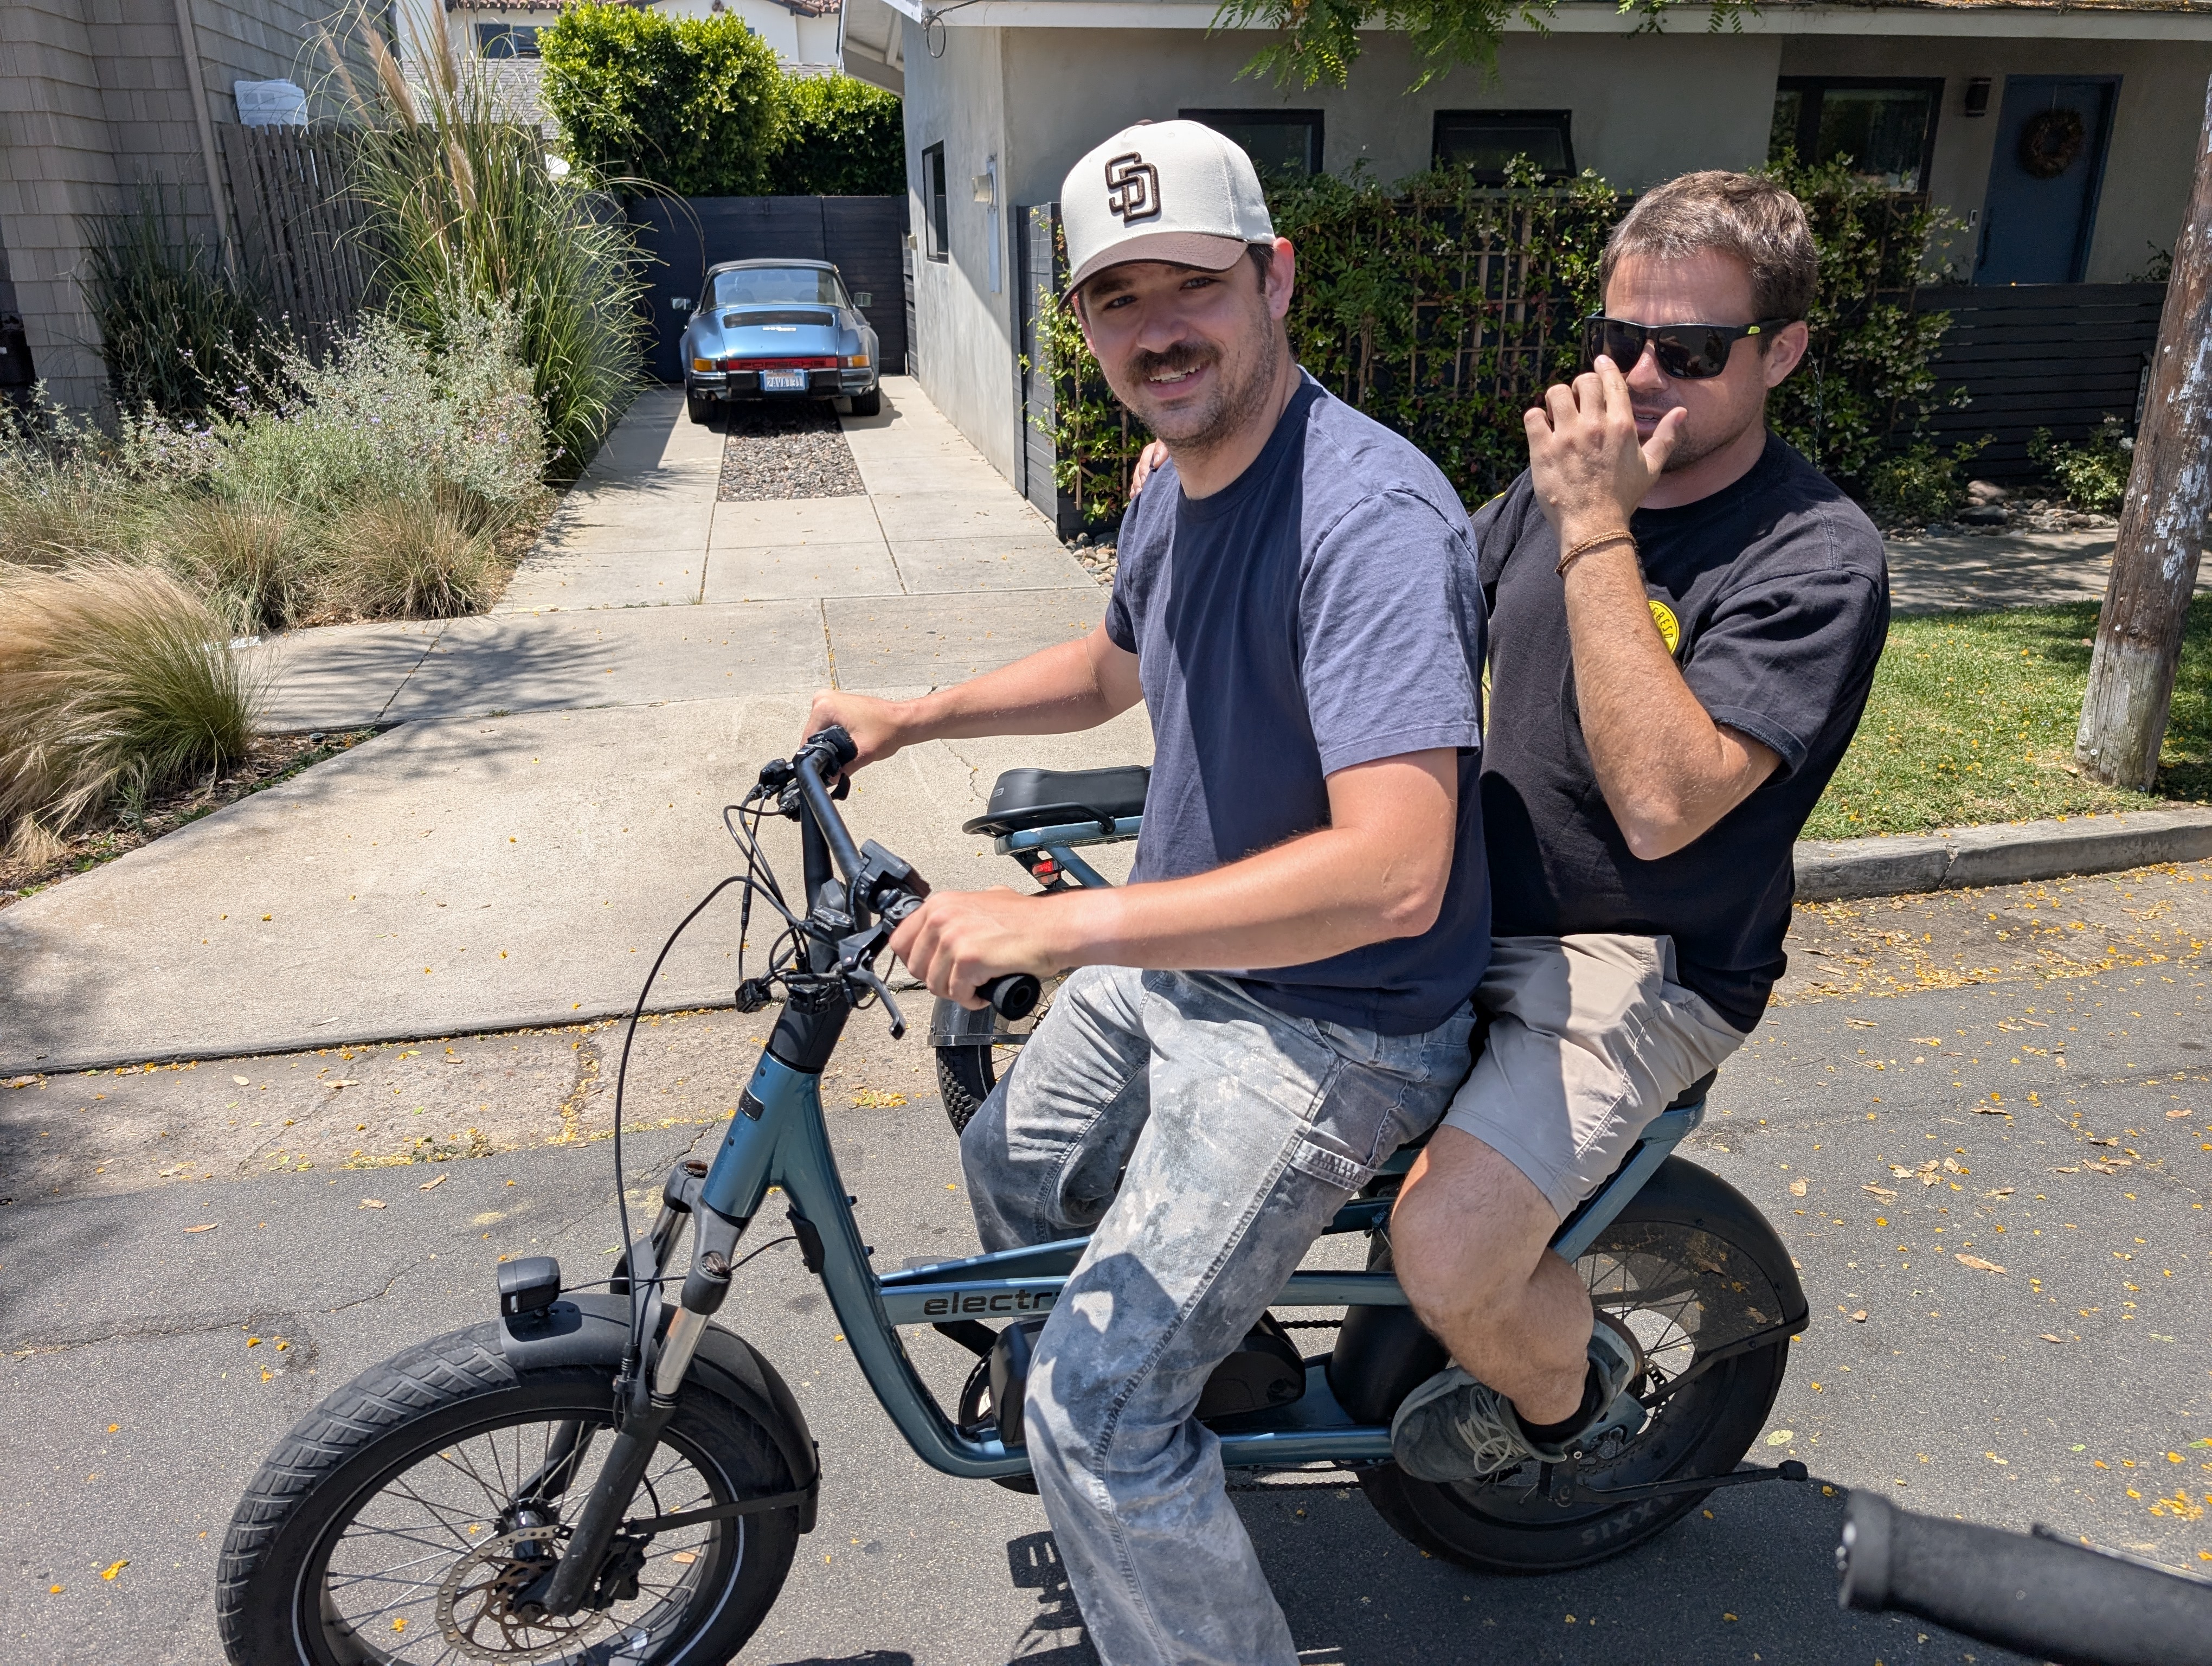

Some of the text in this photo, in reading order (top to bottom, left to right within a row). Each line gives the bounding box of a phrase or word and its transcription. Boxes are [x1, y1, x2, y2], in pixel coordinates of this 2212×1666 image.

[1105, 151, 1161, 223] SD
[740, 361, 825, 369] PORSCHE
[2136, 368, 2147, 420] 1300
[1650, 606, 1674, 638] GRESO
[924, 1289, 1060, 1315] electr
